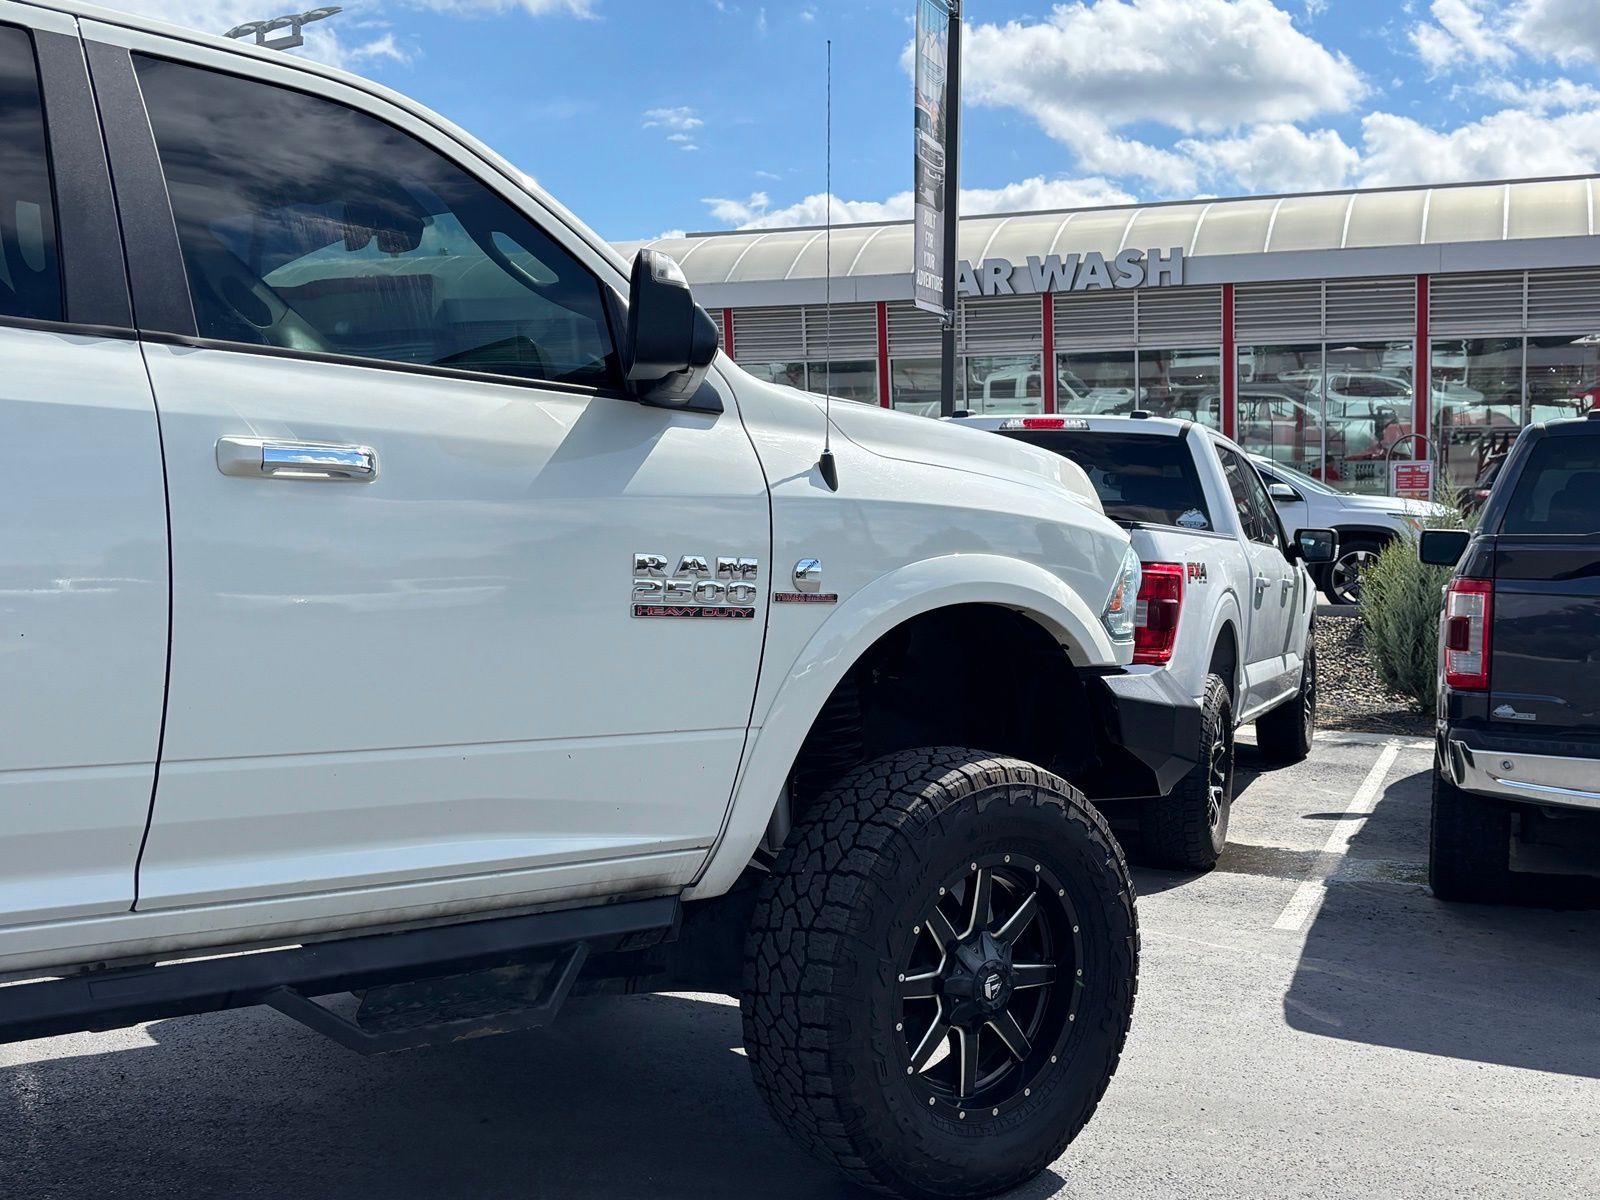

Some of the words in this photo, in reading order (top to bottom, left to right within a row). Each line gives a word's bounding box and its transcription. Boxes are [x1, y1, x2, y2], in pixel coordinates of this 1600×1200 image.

[923, 209, 936, 229] BUILT
[924, 231, 934, 248] FOR
[923, 251, 936, 270] YOUR
[916, 268, 944, 292] ADVENTURE
[957, 258, 1017, 297] AR
[1026, 247, 1183, 293] WASH
[633, 552, 759, 580] RAM
[632, 578, 757, 604] 2500
[637, 605, 699, 616] HEAVY
[701, 606, 754, 617] DUTY
